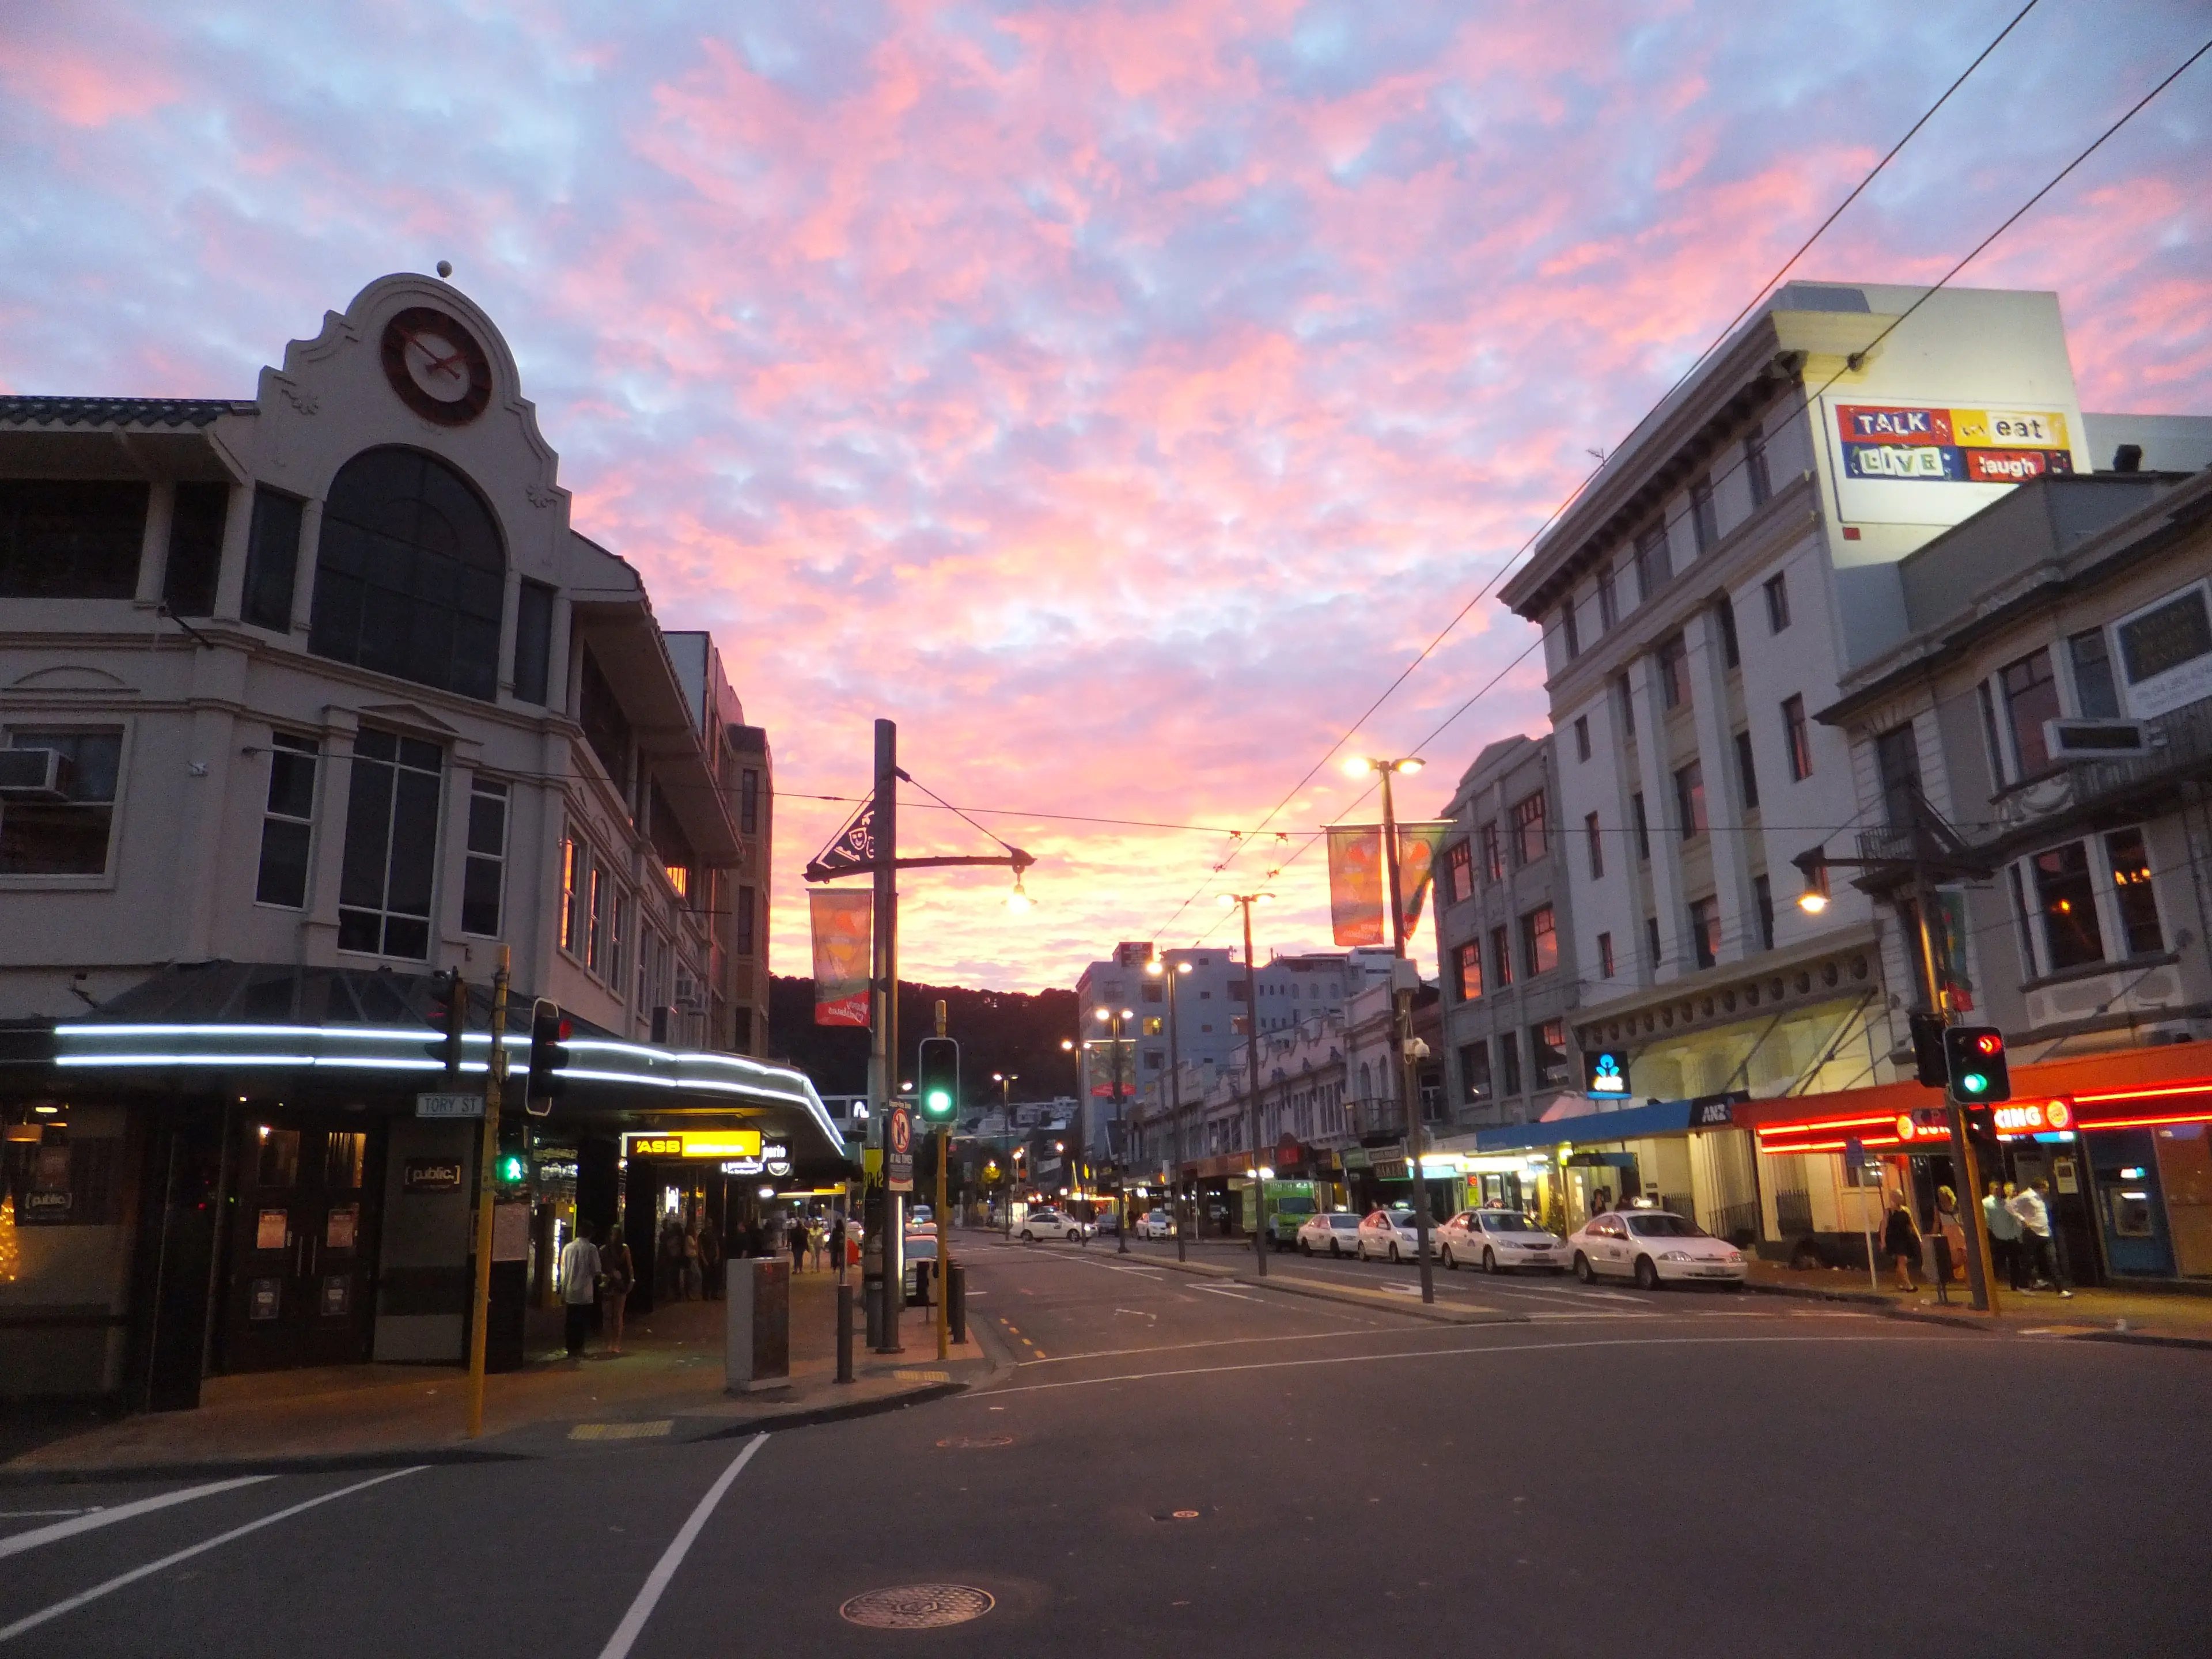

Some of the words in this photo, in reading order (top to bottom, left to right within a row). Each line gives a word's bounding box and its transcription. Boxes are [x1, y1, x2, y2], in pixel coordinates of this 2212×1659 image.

[1858, 412, 1926, 435] TALK
[1995, 418, 2044, 439] eat
[1864, 452, 1937, 473] LIVE
[1978, 455, 2036, 477] laugh
[425, 1097, 454, 1112] TORY
[462, 1097, 477, 1112] ST
[1702, 1103, 1726, 1123] ANZ
[637, 1140, 680, 1153] ASB
